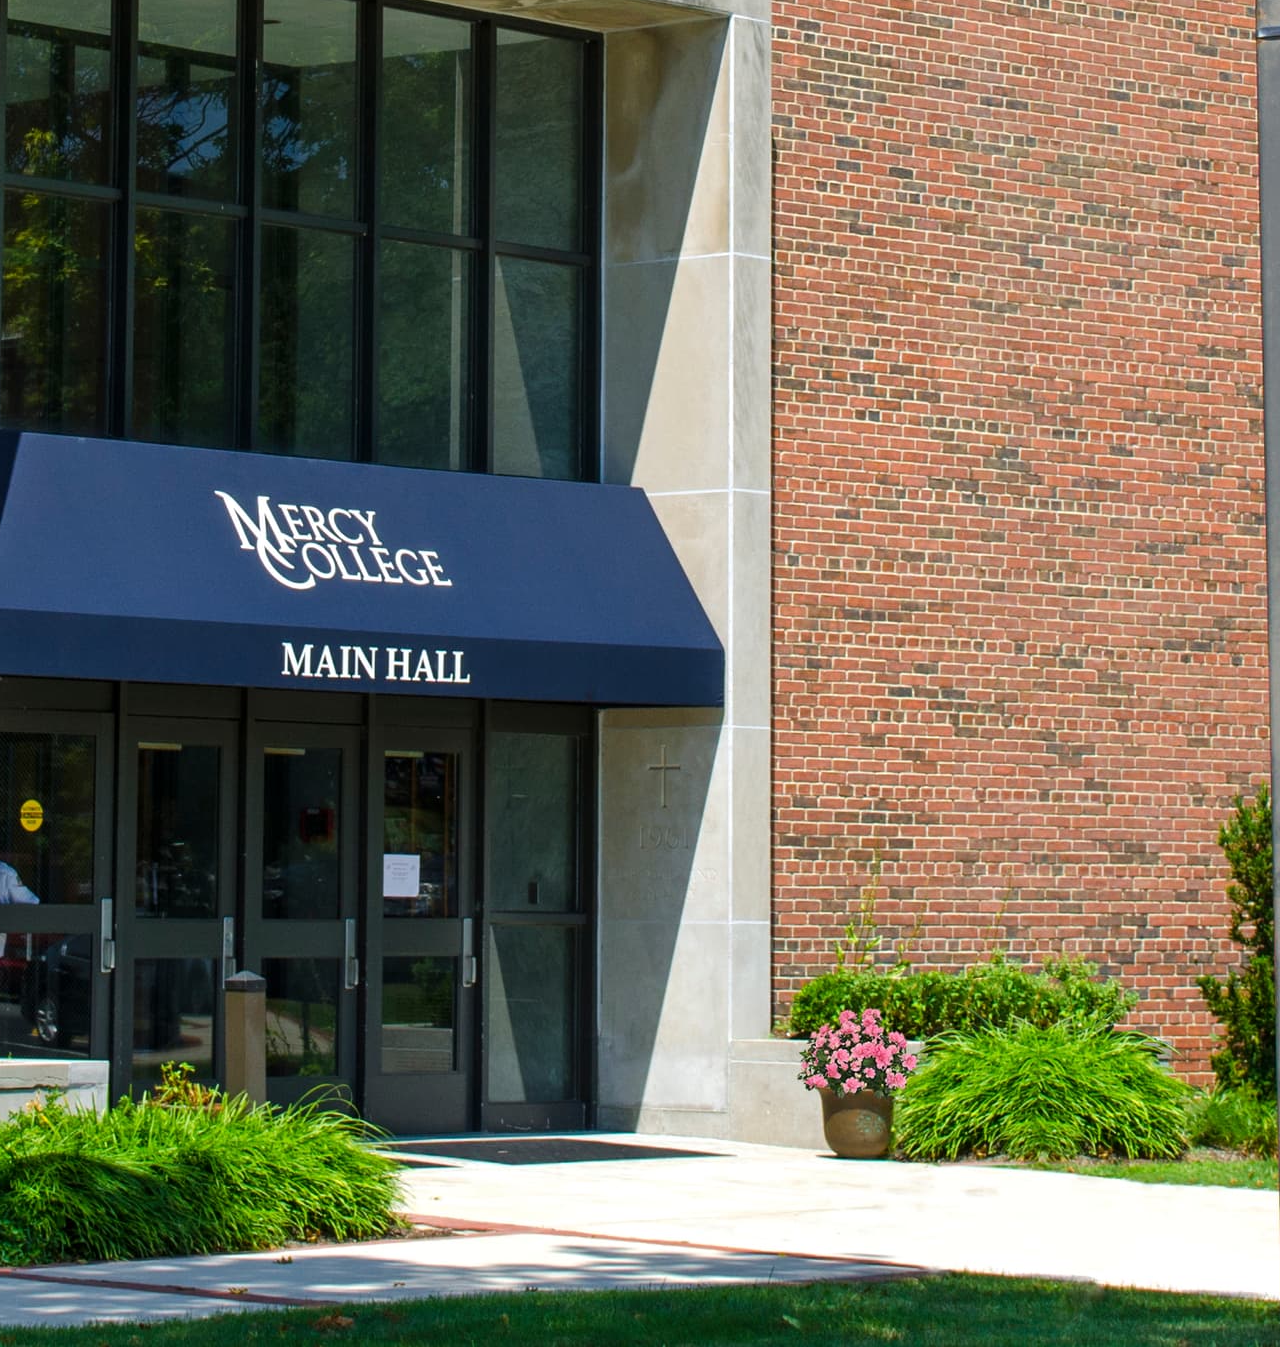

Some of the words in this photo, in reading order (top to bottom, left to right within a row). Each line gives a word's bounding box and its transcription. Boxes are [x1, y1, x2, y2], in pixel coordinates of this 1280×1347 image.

[214, 490, 384, 569] MERCY
[256, 535, 453, 590] COLLEGE
[281, 642, 376, 679] MAIN
[385, 647, 471, 684] HALL
[640, 826, 689, 851] 1961
